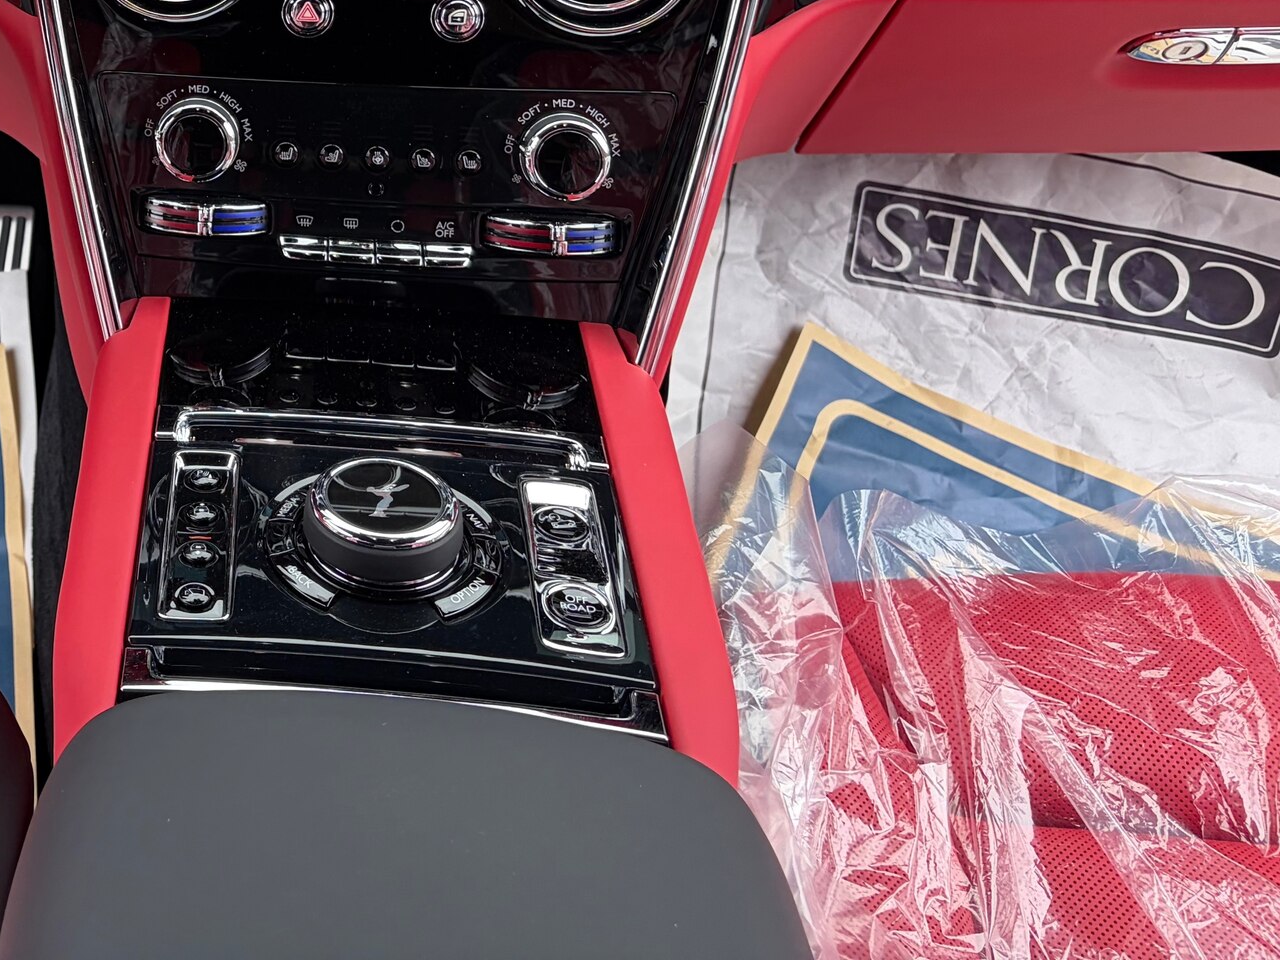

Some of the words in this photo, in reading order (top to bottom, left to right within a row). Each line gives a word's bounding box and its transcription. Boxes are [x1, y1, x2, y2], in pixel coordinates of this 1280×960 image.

[144, 118, 155, 137] OFF
[156, 89, 178, 109] SOFT
[188, 85, 210, 94] MED
[219, 91, 243, 113] HIGH
[241, 118, 253, 142] MAX
[504, 134, 516, 154] OFF
[517, 104, 541, 125] SOFT
[552, 99, 576, 108] MED
[585, 106, 610, 128] HIGH
[608, 133, 621, 157] MAX
[435, 220, 455, 230] A/C
[435, 229, 455, 238] OFF
[871, 202, 1266, 331] CORNES
[466, 513, 489, 529] NAV
[287, 565, 313, 588] BACK
[450, 576, 486, 603] OPTION
[560, 601, 596, 614] ROAD
[565, 594, 588, 605] OFF
